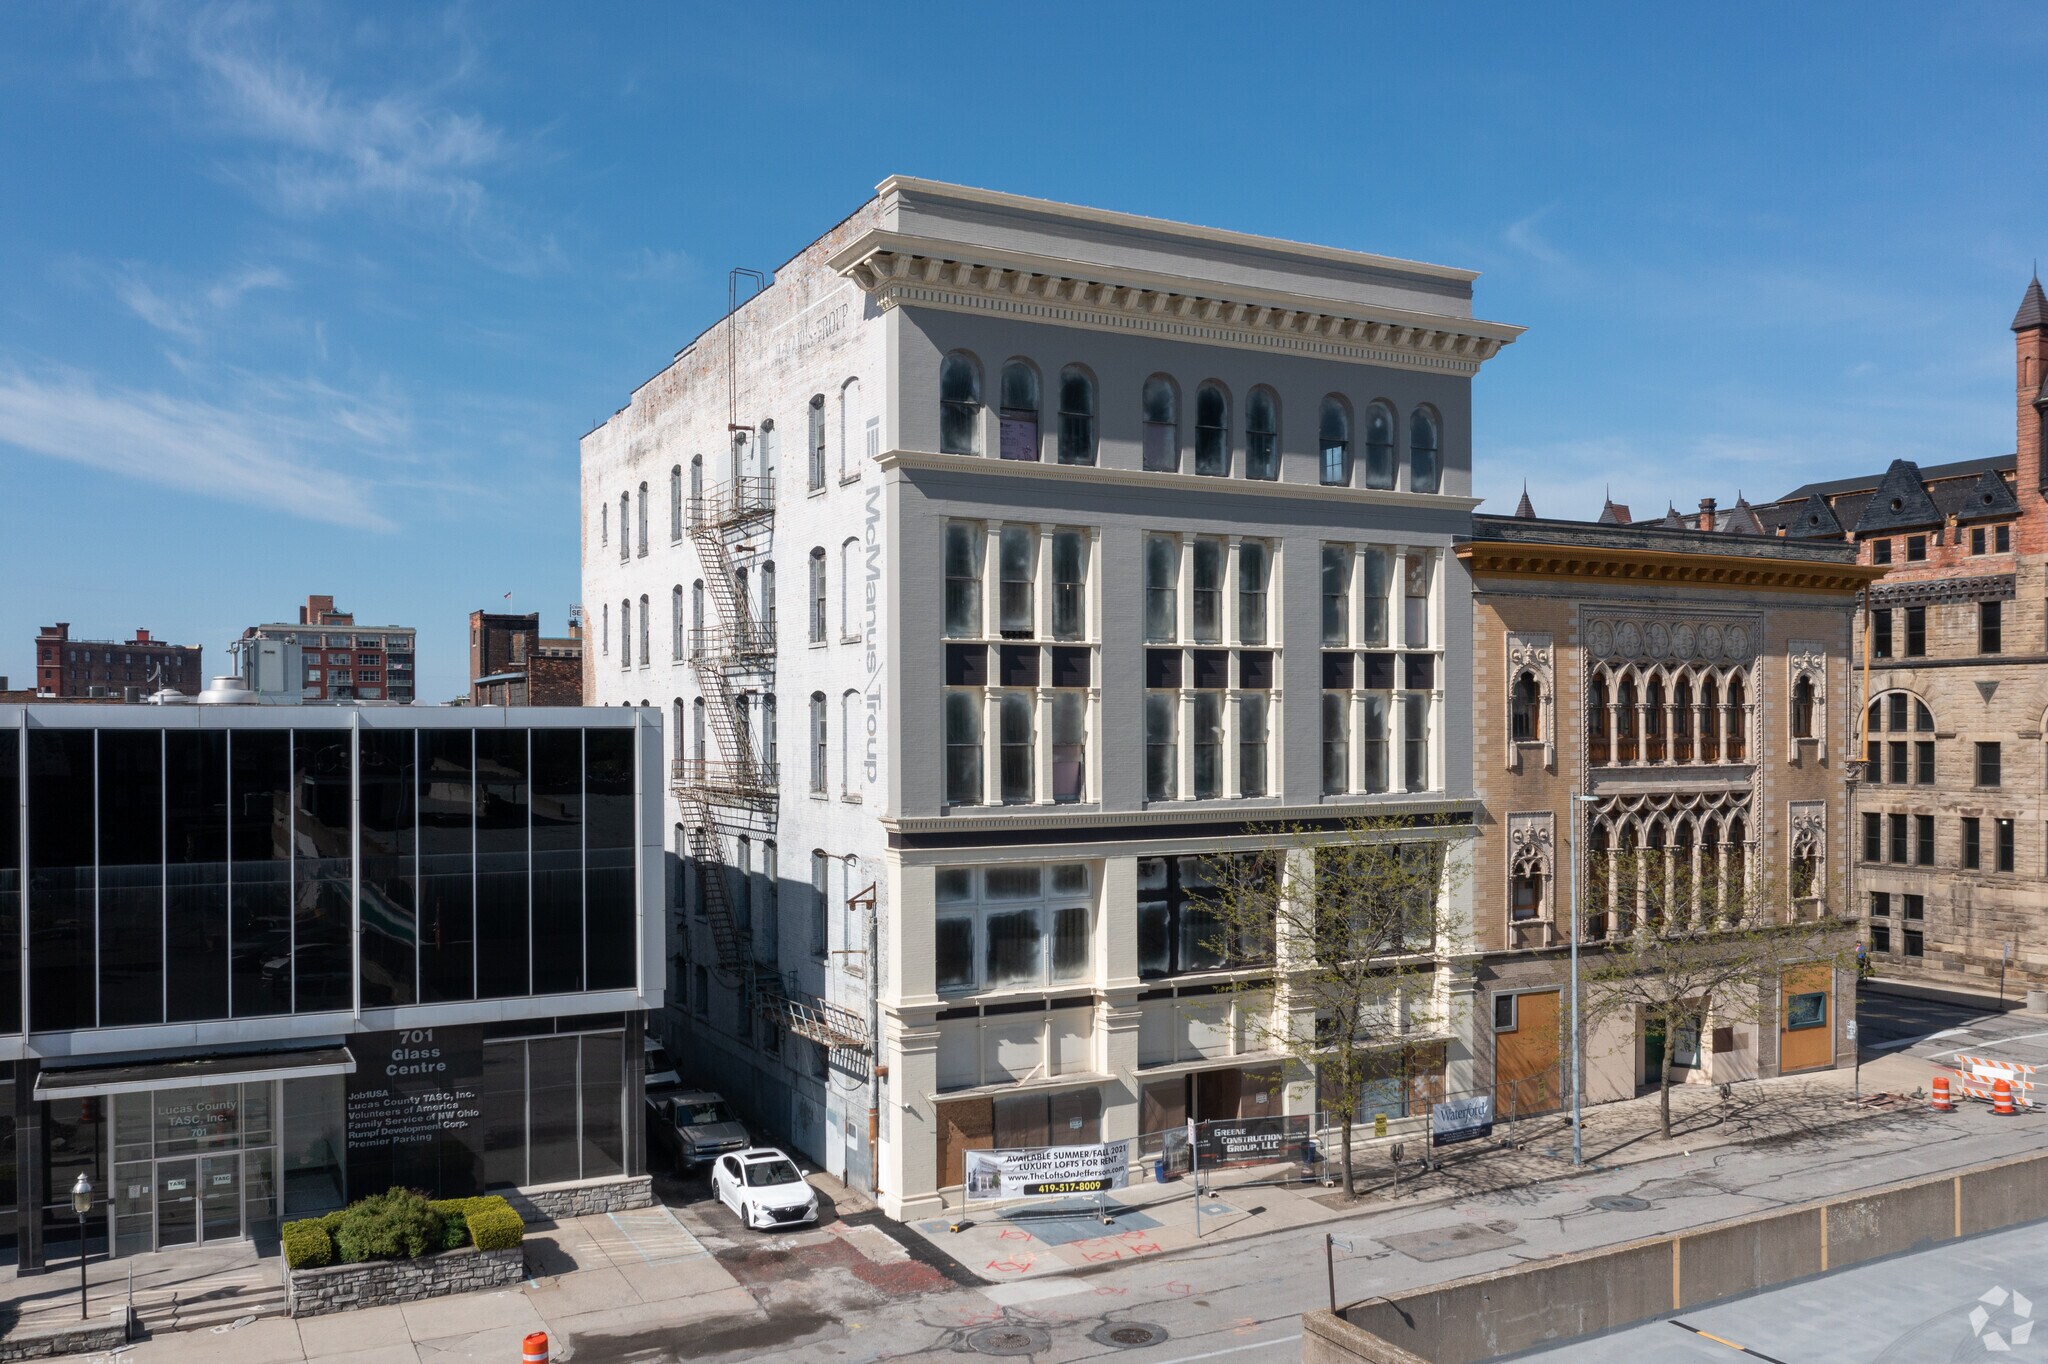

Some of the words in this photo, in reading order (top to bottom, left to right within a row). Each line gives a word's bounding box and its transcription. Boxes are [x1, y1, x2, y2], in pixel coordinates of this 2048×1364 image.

[399, 1028, 433, 1044] 701
[391, 1048, 441, 1061] Glass
[386, 1062, 447, 1076] Centre
[158, 1105, 193, 1115] Lucas
[196, 1101, 237, 1111] County
[348, 1102, 380, 1110] Lucas
[383, 1096, 420, 1106] County
[423, 1092, 454, 1103] TASC,
[456, 1091, 475, 1099] Inc.
[348, 1108, 401, 1120] Volunteers
[403, 1105, 414, 1113] of
[416, 1102, 459, 1113] America
[1440, 1102, 1486, 1124] Waterford
[168, 1114, 204, 1126] TASC,
[206, 1113, 228, 1122] Inc.
[348, 1119, 382, 1130] Family
[385, 1115, 424, 1126] Service
[426, 1112, 436, 1121] of
[437, 1111, 455, 1120] NW
[457, 1109, 480, 1117] Ohio
[191, 1128, 207, 1137] 701
[381, 1122, 442, 1136] Development
[443, 1120, 469, 1130] Corp.
[348, 1138, 391, 1149] Premier
[393, 1133, 433, 1144] Parking
[1261, 1140, 1280, 1149] LLC
[1005, 1152, 1051, 1163] AVAILABLE
[1053, 1147, 1110, 1160] SUMMER/FALL
[1110, 1144, 1127, 1155] 2021
[1018, 1161, 1052, 1171] LUXURY
[1054, 1159, 1080, 1169] LOFTS
[1081, 1157, 1098, 1167] FOR
[1100, 1155, 1118, 1165] RENT
[1007, 1164, 1125, 1181] www.TheLoftsOnJefferson.com
[1038, 1181, 1101, 1193] 419-517-8009
